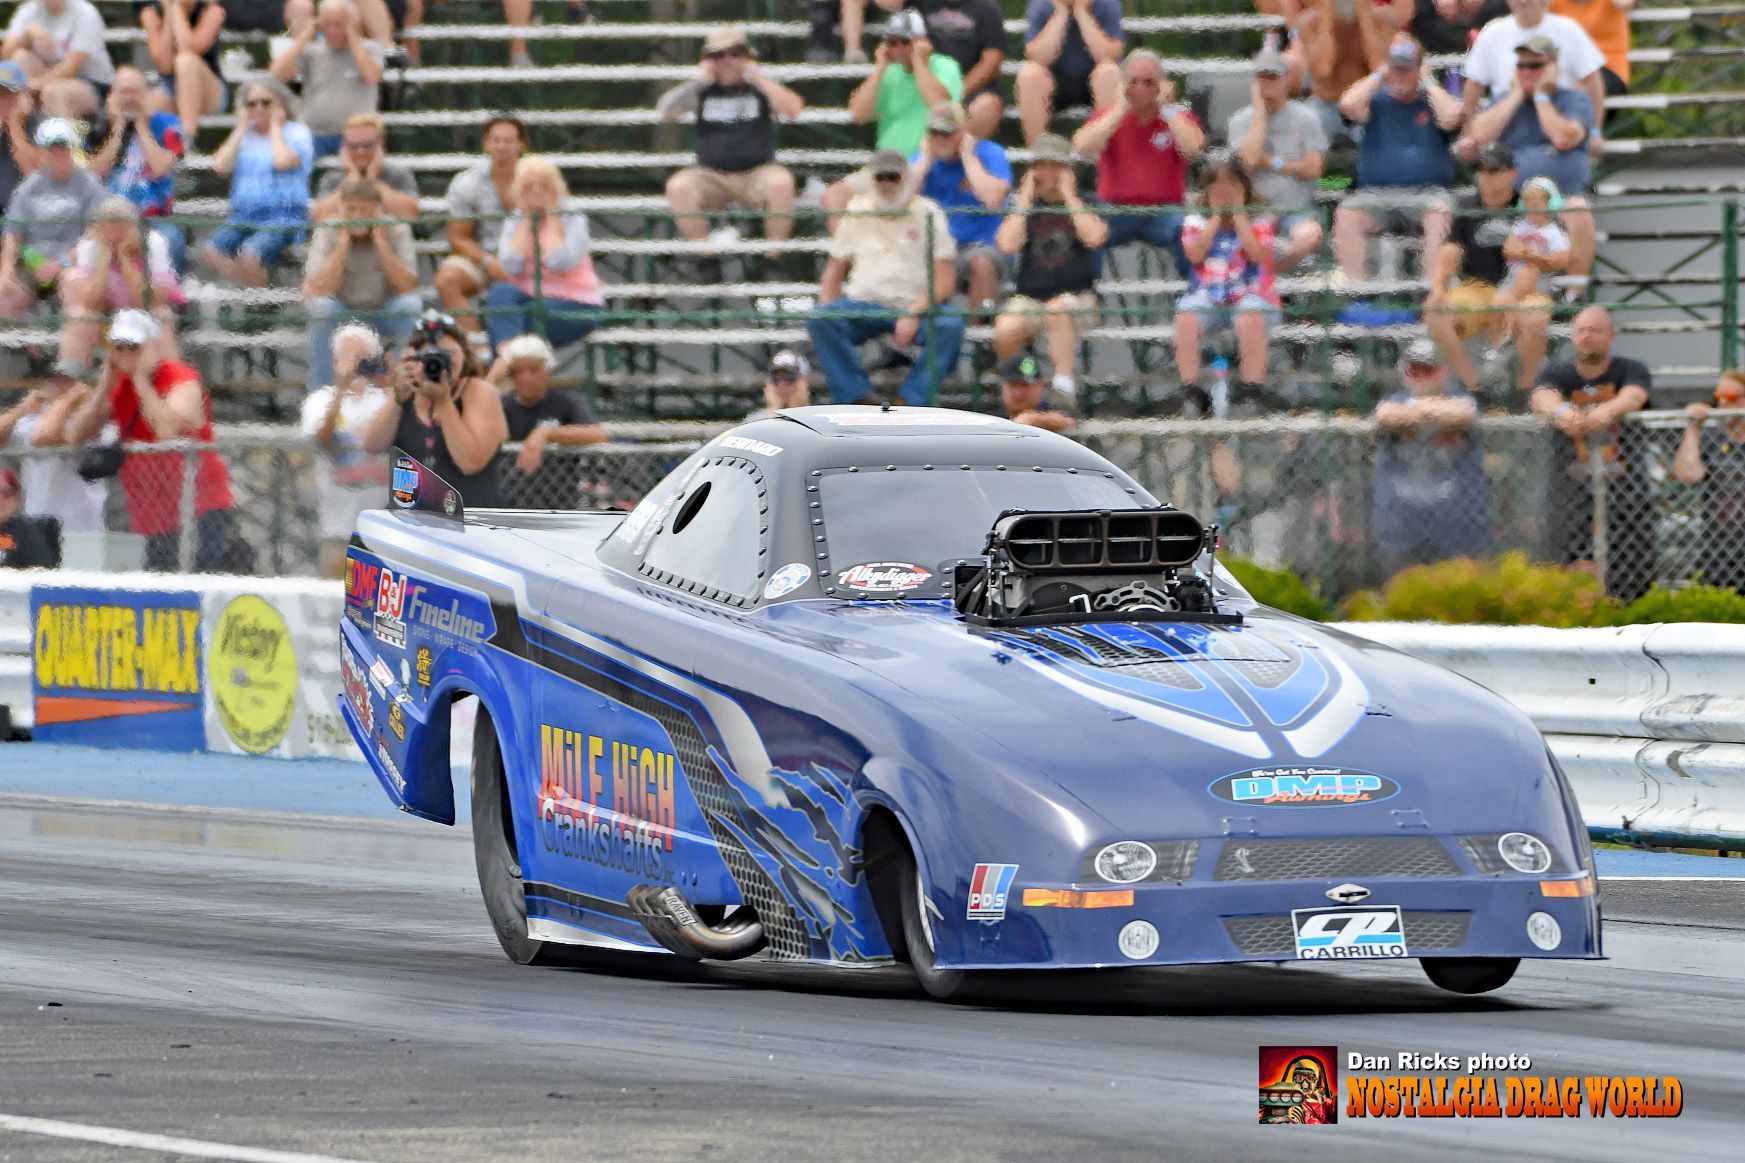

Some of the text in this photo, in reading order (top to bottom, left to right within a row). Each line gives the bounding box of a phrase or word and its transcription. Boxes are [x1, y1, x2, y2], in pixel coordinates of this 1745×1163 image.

[408, 584, 486, 644] Fineline
[1231, 775, 1382, 800] DMP
[542, 797, 663, 880] Crankshafts
[665, 897, 694, 924] RAVEN
[970, 893, 1005, 907] PDS
[1300, 945, 1404, 959] CARRILLO
